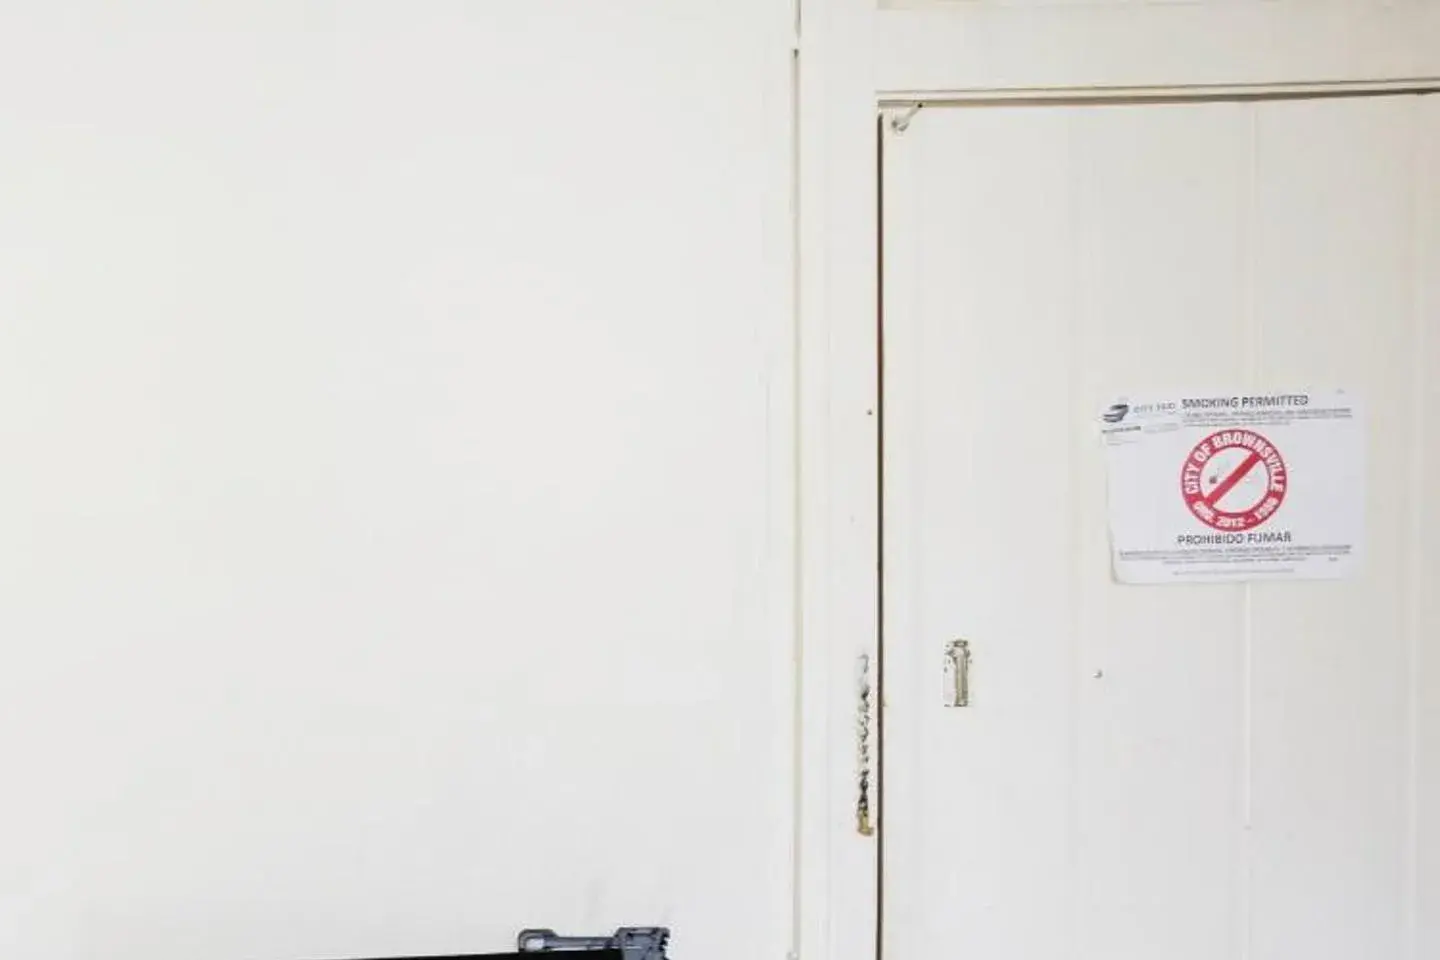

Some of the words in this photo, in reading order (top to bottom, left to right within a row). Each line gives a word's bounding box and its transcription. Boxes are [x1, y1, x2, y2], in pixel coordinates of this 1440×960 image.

[1181, 397, 1239, 409] SMOKING
[1242, 395, 1308, 407] PERMITTED
[1184, 462, 1200, 494] CITY
[1193, 443, 1211, 462] OF
[1212, 432, 1284, 492] BROWNSVILLE
[1177, 533, 1244, 544] PROHIBIDO
[1247, 531, 1291, 543] FUMAR
